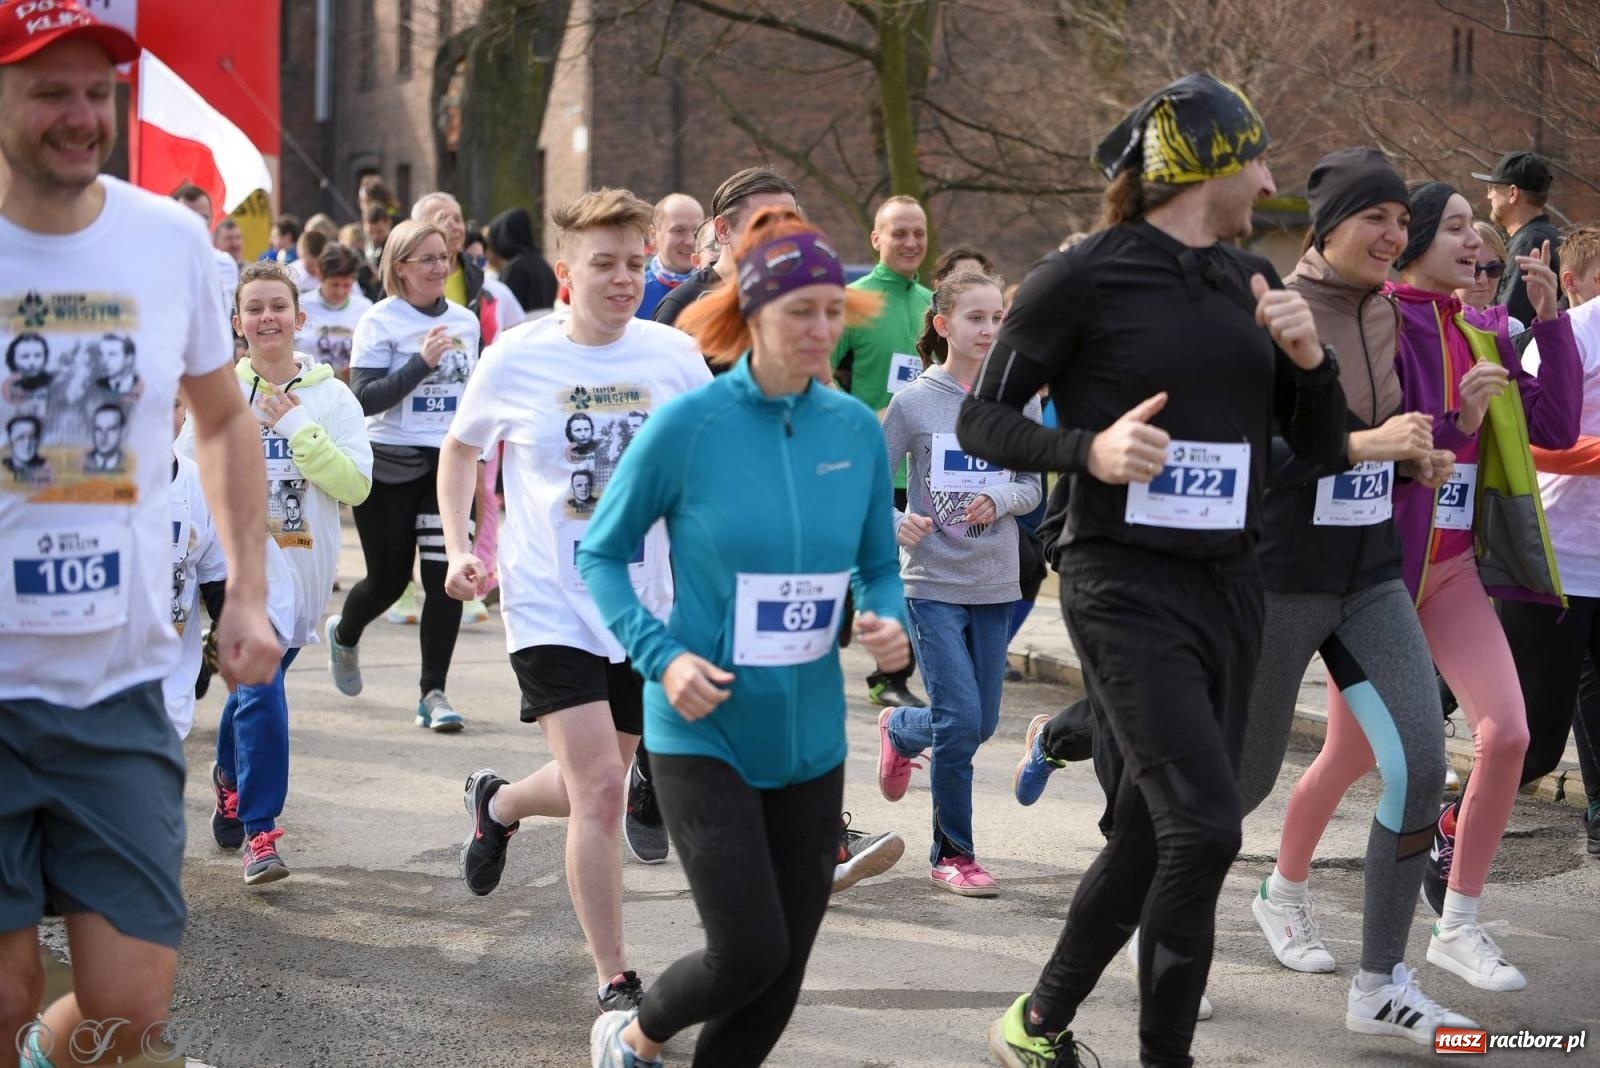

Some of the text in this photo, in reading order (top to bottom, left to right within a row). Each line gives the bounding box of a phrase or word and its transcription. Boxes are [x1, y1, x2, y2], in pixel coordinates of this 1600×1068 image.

[426, 398, 446, 411] 94
[594, 390, 640, 405] WILCZYM
[964, 454, 988, 471] 16
[1169, 467, 1223, 497] 122
[1351, 473, 1384, 499] 124
[38, 555, 107, 594] 106
[782, 601, 818, 632] 69
